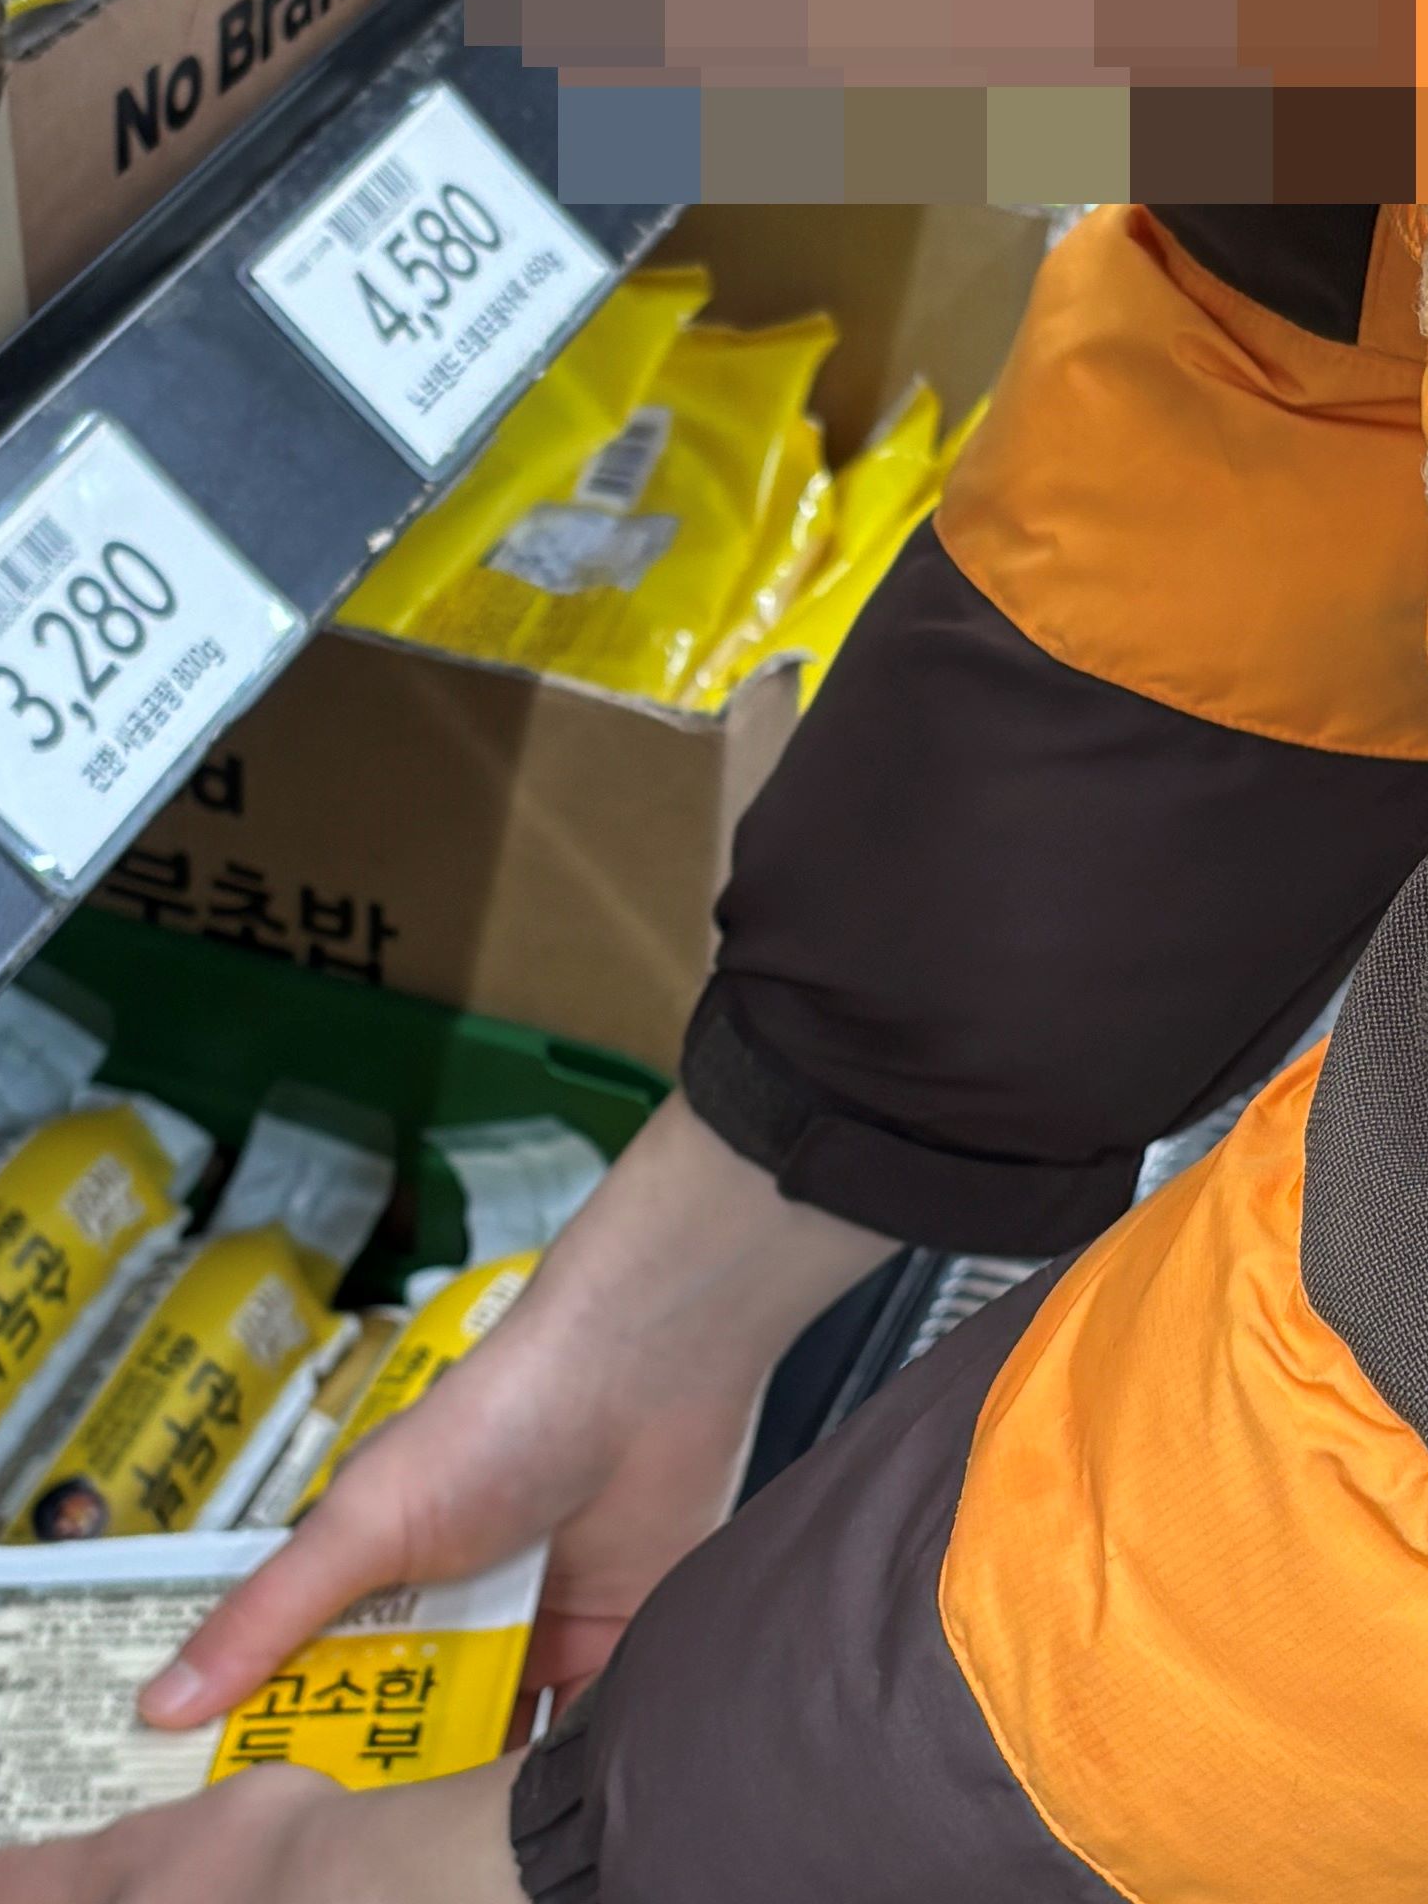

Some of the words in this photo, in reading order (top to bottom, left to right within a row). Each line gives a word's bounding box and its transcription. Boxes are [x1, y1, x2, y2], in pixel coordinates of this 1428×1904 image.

[115, 62, 204, 176] No
[356, 182, 503, 350] 4,580
[242, 1664, 438, 1720] 고소한
